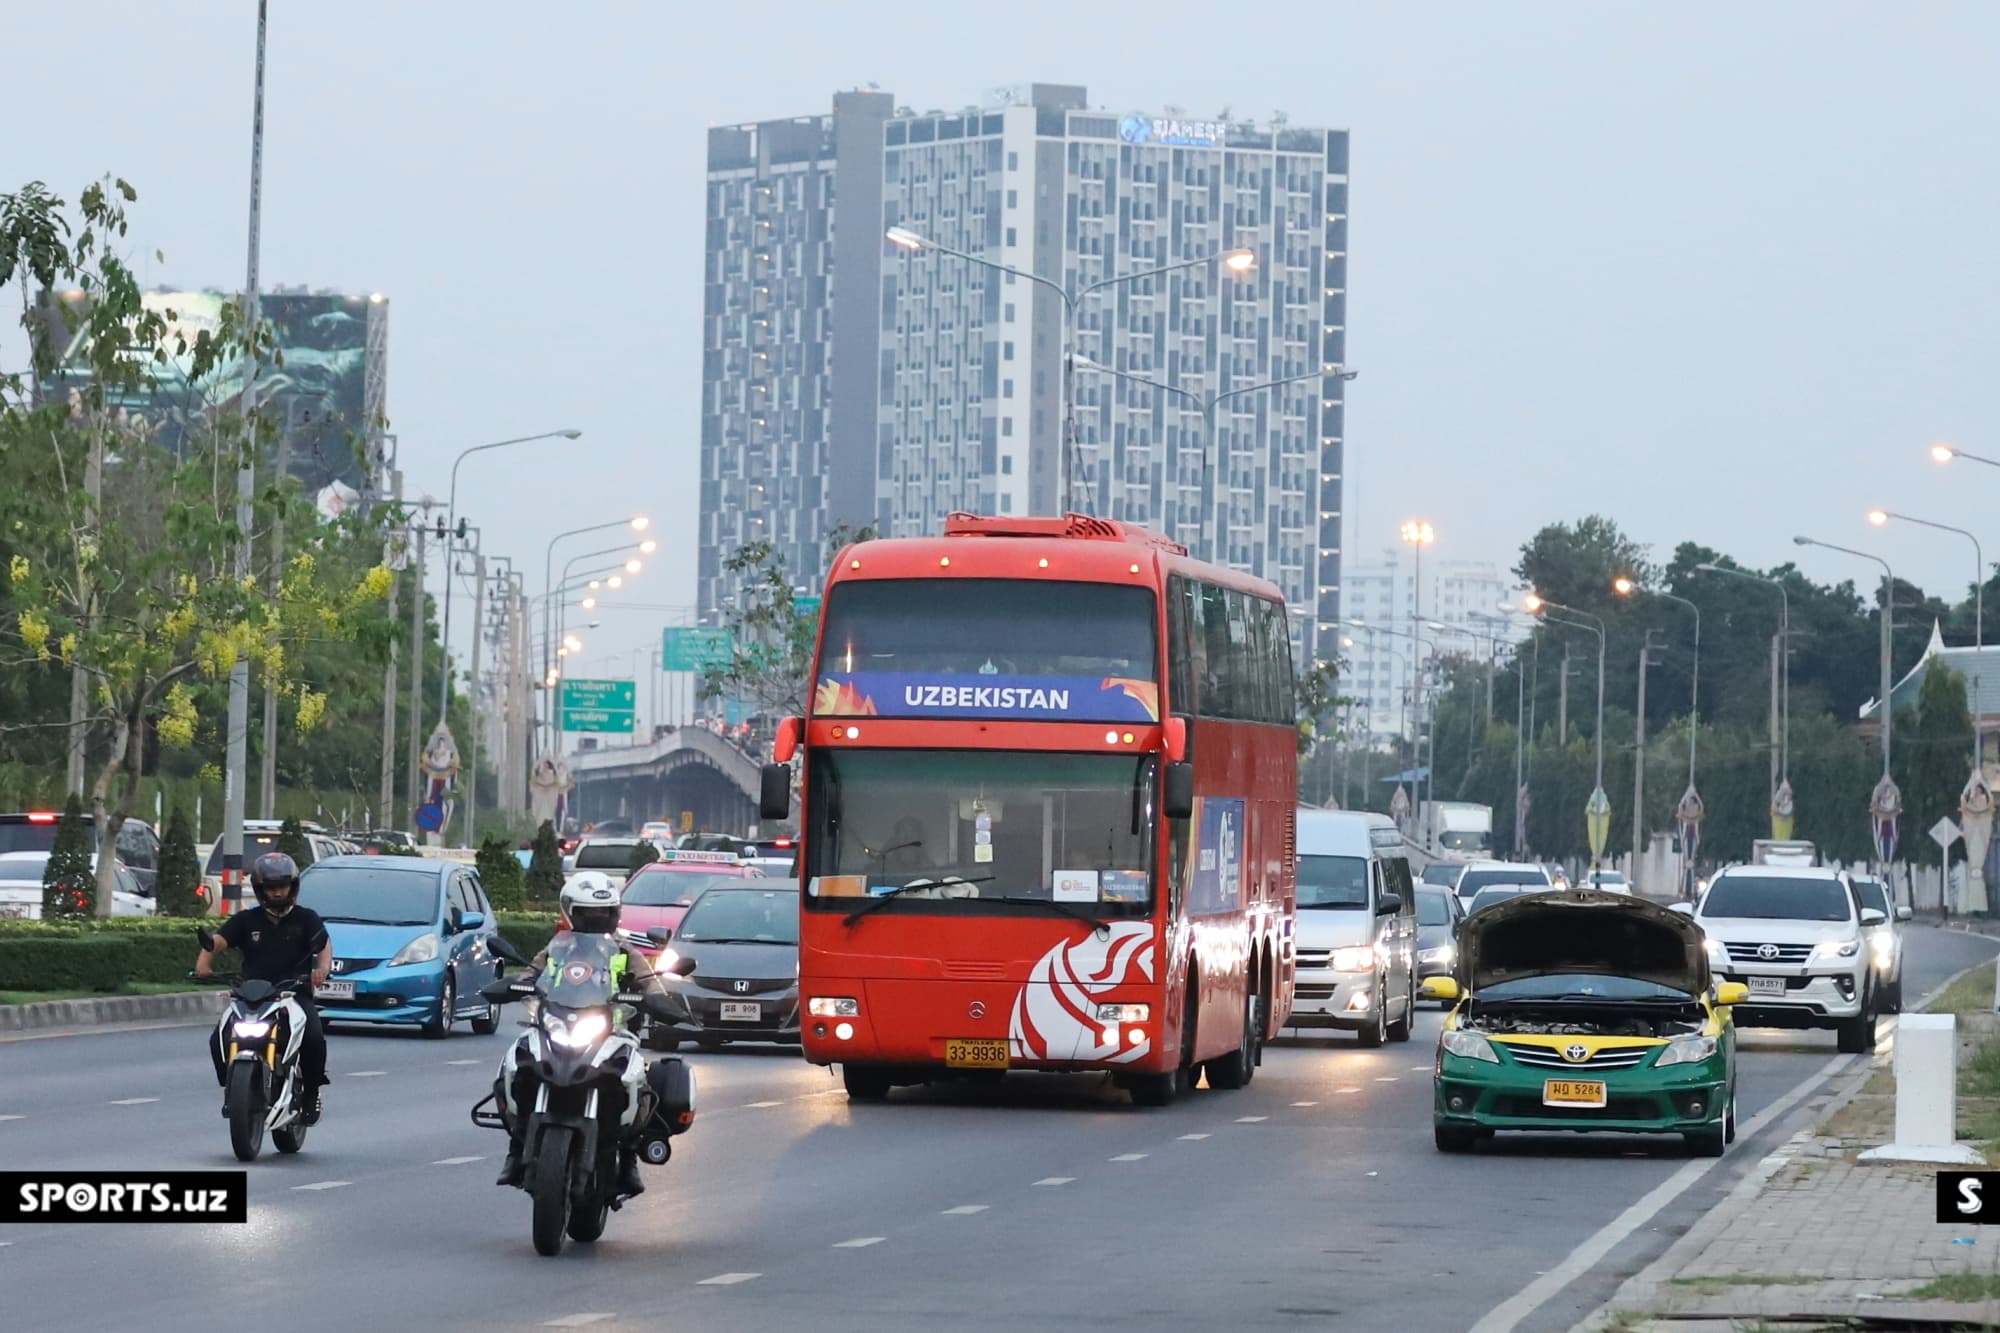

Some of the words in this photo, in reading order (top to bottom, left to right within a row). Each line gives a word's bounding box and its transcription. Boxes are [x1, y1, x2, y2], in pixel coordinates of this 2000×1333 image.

[905, 685, 1069, 710] UZBEKISTAN
[950, 1046, 1005, 1062] 33-9936
[1575, 1084, 1601, 1097] 5284
